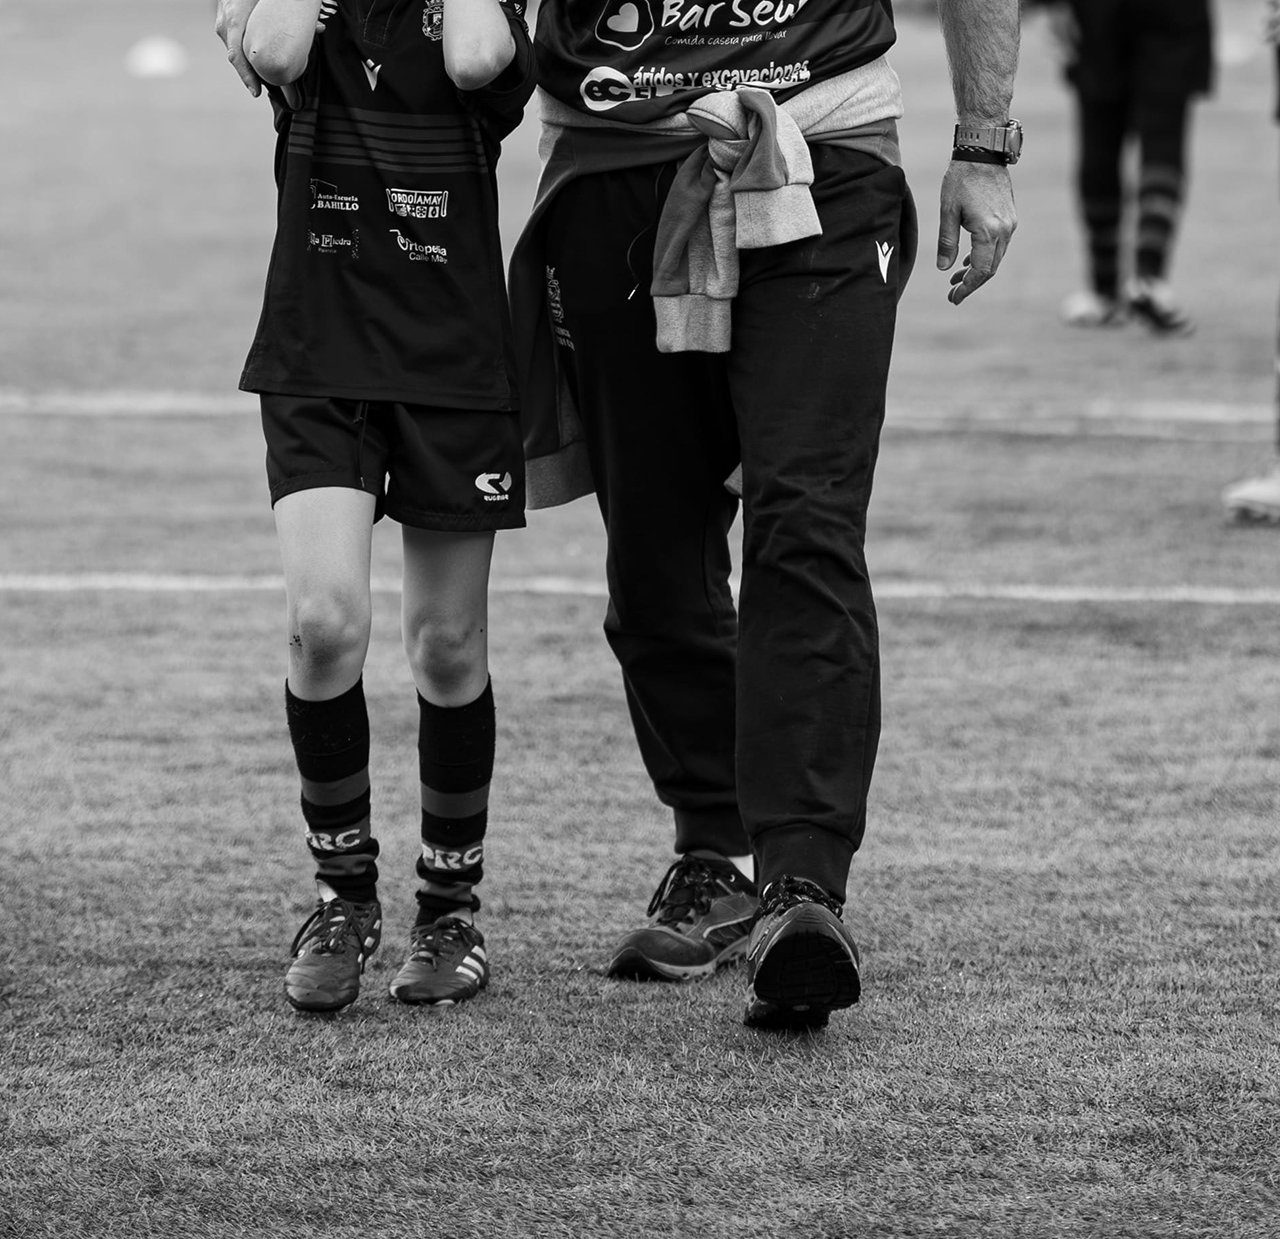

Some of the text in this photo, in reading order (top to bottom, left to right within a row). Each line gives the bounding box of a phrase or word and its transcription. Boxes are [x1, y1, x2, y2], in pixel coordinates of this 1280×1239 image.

[665, 35, 705, 46] Comida
[707, 35, 739, 45] casera
[633, 66, 684, 87] áridos
[317, 200, 359, 211] BAHILLO
